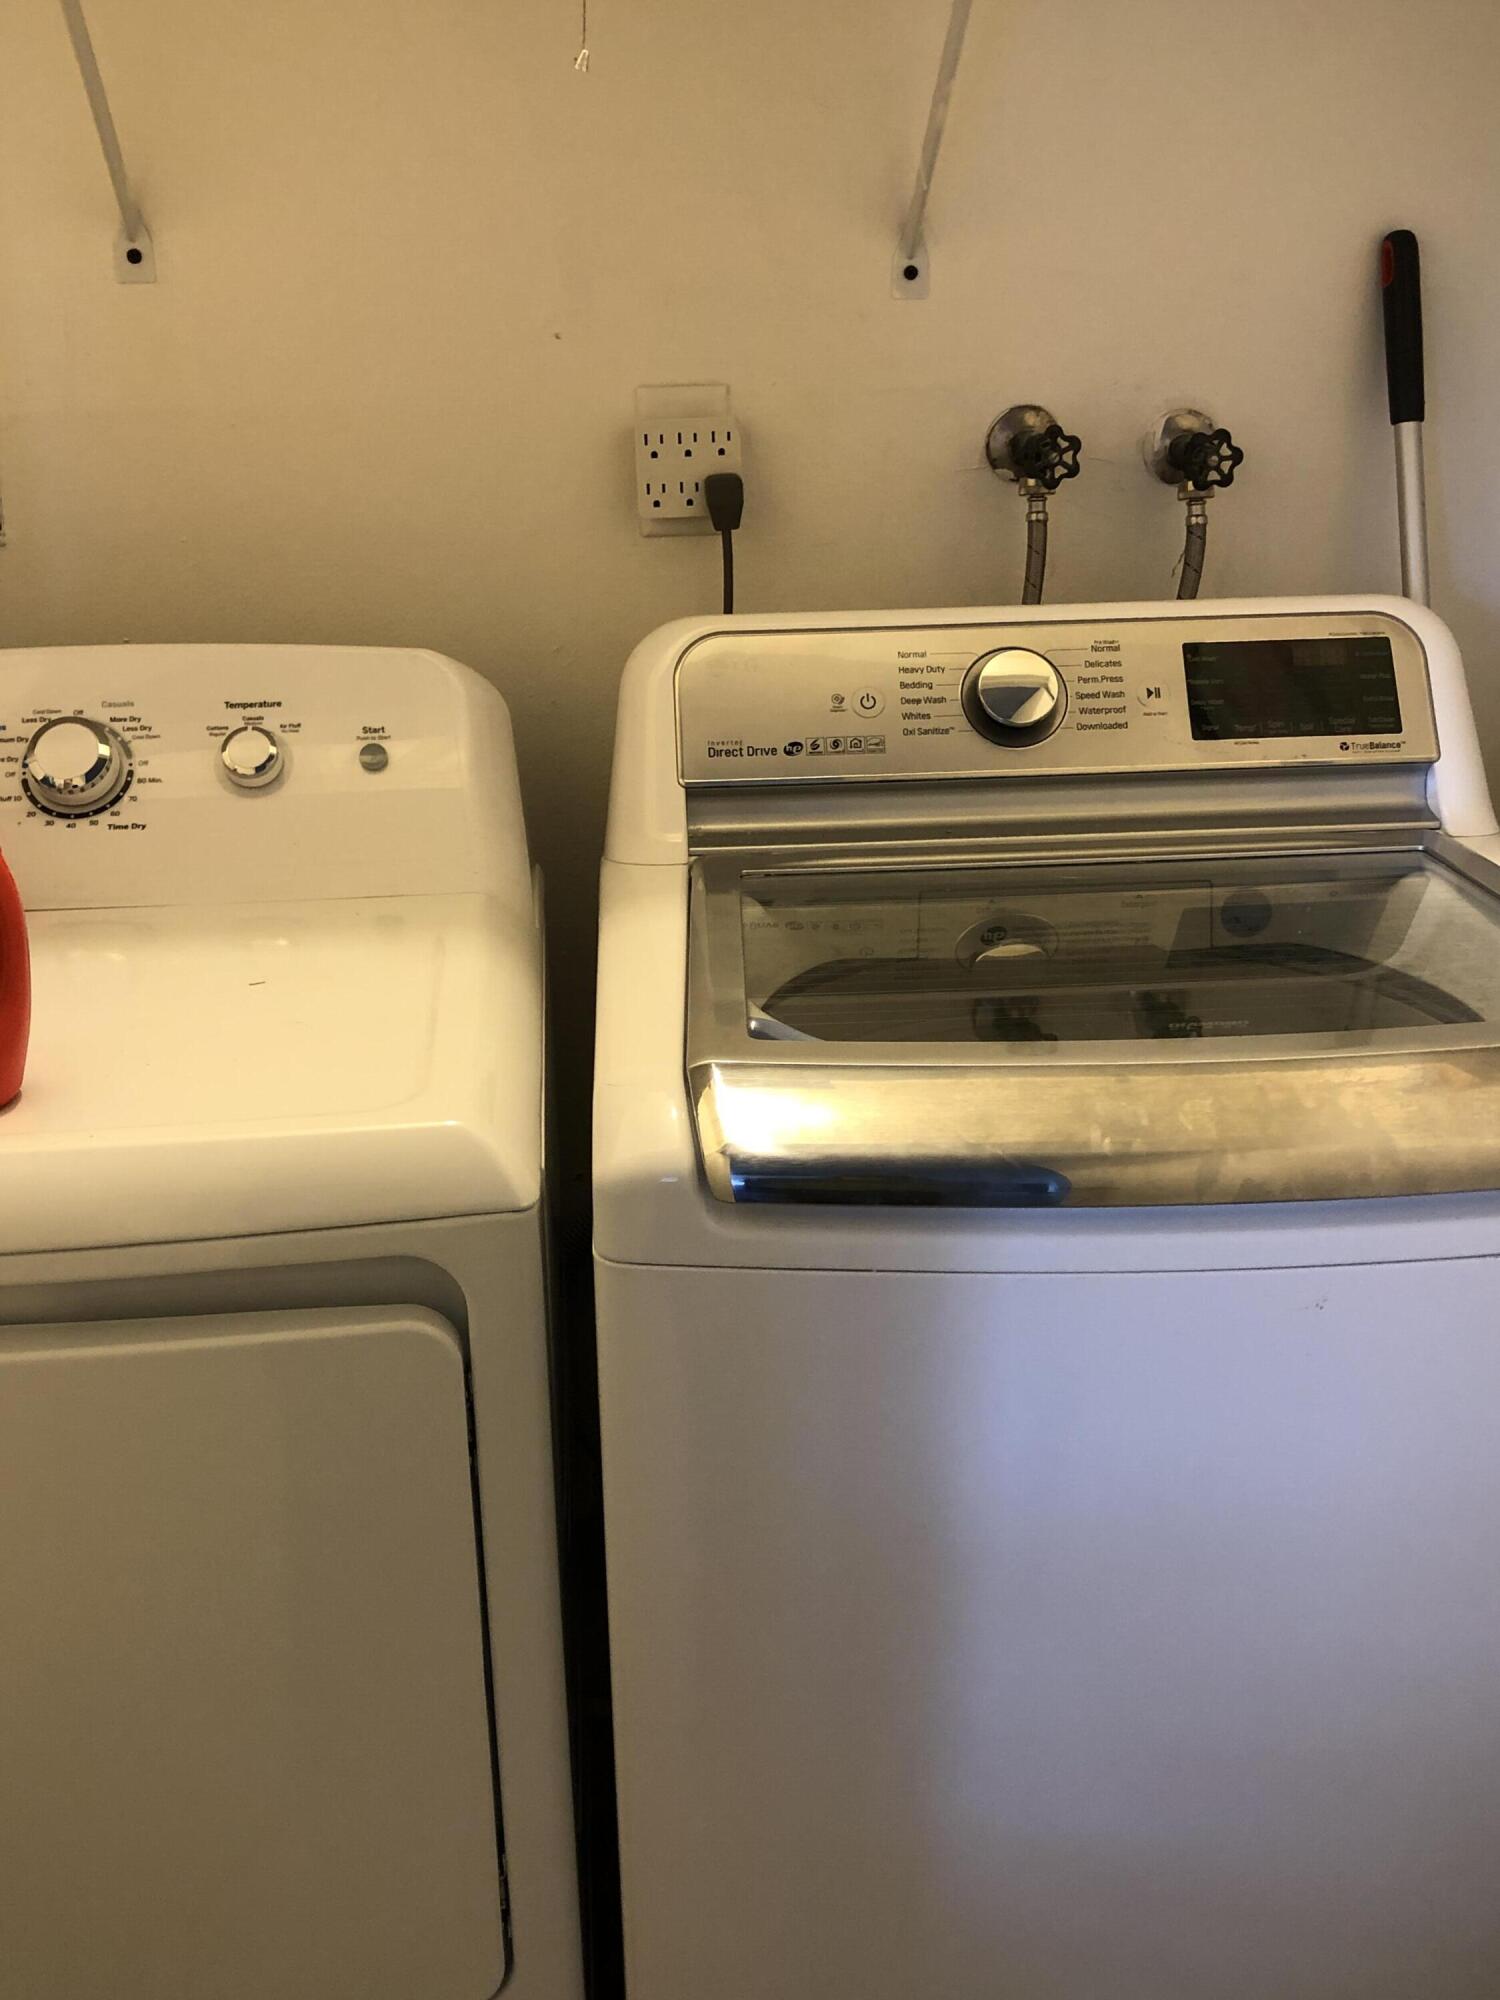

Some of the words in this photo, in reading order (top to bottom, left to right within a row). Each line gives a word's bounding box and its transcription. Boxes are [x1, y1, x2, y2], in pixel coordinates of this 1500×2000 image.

[1090, 644, 1120, 652] Normal
[897, 650, 926, 658] Normal
[1084, 660, 1122, 668] Delicates
[898, 666, 924, 674] Heavy
[926, 665, 946, 673] Duty
[899, 681, 933, 689] Bedding
[1075, 691, 1100, 700] Speed
[1102, 690, 1125, 698] Wash
[224, 700, 282, 709] Temperature
[900, 697, 922, 705] Deep
[924, 696, 947, 704] Wash
[1078, 705, 1126, 715] Waterproof
[901, 712, 931, 720] Whites
[362, 726, 385, 734] Start
[1076, 722, 1128, 731] Downloaded
[902, 728, 916, 736] Oxi
[708, 747, 744, 758] Direct
[747, 746, 778, 757] Drive
[131, 822, 147, 831] Dry
